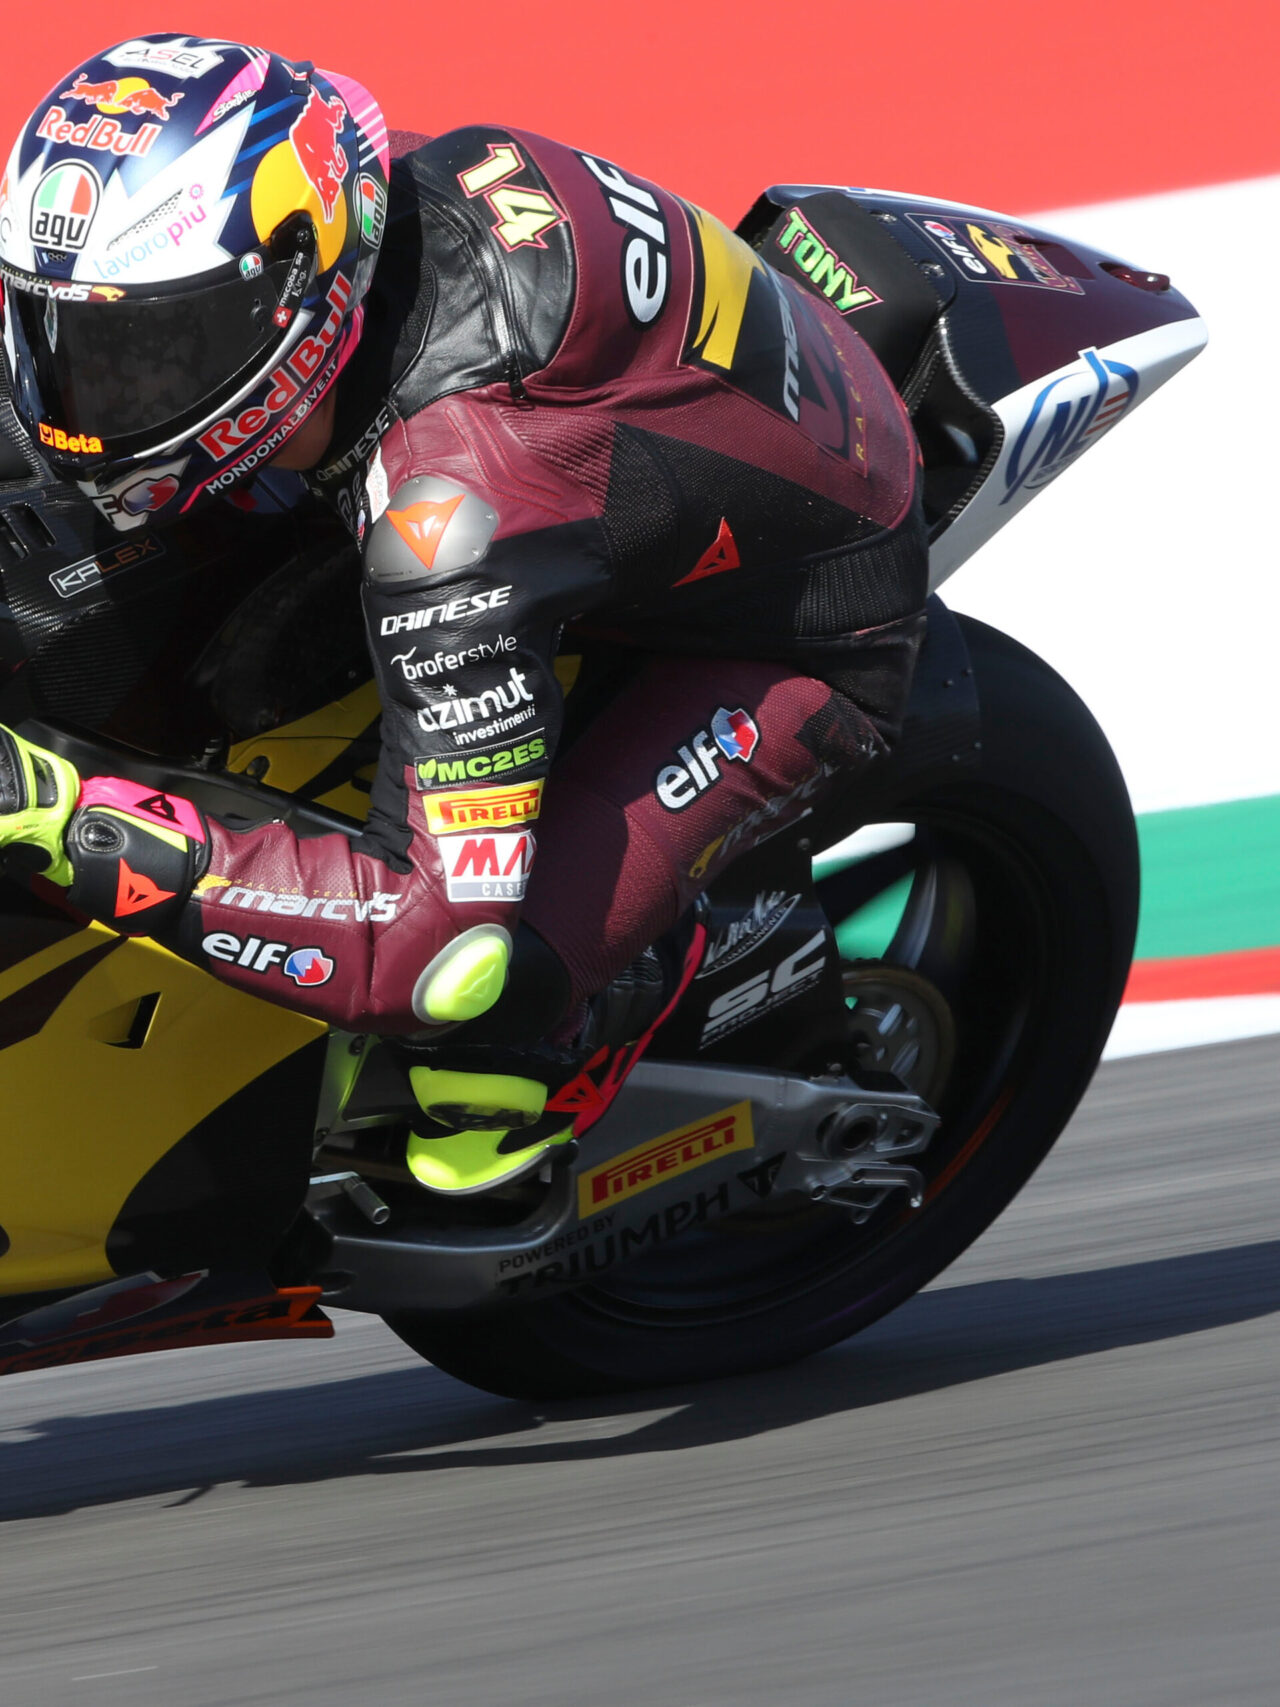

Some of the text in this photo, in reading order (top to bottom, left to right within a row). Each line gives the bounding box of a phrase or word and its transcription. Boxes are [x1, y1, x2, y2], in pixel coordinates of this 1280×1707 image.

[38, 106, 162, 157] Red Bull
[459, 145, 566, 250] 14
[36, 211, 85, 250] agv
[581, 155, 668, 323] elf
[942, 238, 987, 274] elf
[778, 208, 878, 313] TONY
[198, 271, 352, 462] Red Bull
[54, 428, 104, 454] Beta
[56, 539, 158, 592] KALEX
[380, 585, 513, 636] DAINESE
[416, 667, 534, 733] azimut
[453, 703, 537, 747] investimenti
[436, 738, 546, 784] MC2ES
[656, 731, 720, 810] elf
[439, 788, 540, 825] PIRELLI
[201, 932, 288, 972] elf
[703, 927, 827, 1034] SC
[591, 1113, 737, 1206] PIRELLI
[496, 1182, 731, 1297] TRIUMPH
[498, 1211, 616, 1273] POWERED BY
